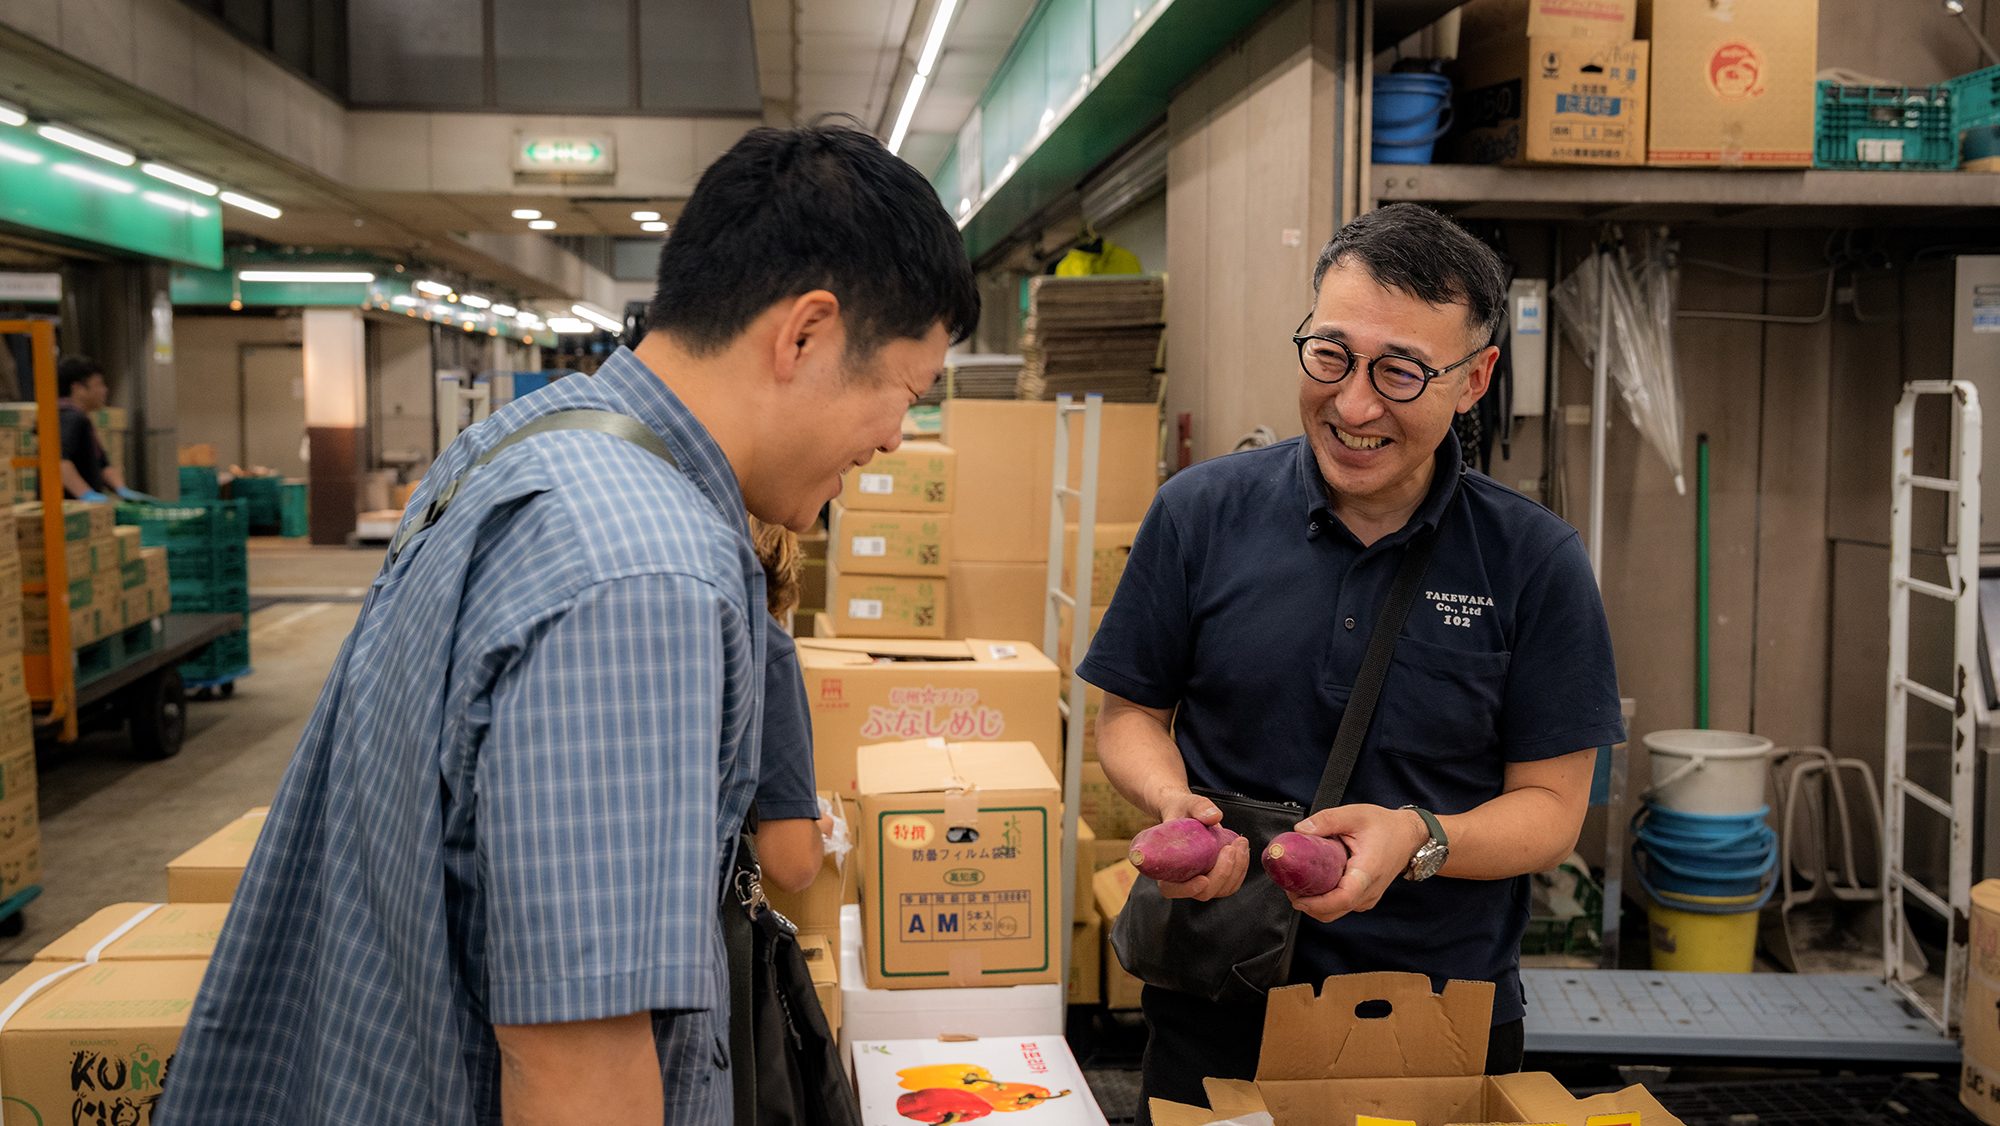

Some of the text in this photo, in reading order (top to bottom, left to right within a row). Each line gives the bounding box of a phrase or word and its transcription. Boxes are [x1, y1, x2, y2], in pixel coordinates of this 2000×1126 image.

[1565, 95, 1614, 115] たまねぎ
[1425, 591, 1495, 607] TAKEWAKA
[1435, 602, 1482, 616] Co., Ltd
[1443, 615, 1471, 628] 102
[862, 708, 1002, 737] ぶなしめじ
[950, 871, 980, 882] 高知産
[908, 913, 926, 933] A
[938, 913, 958, 933] M
